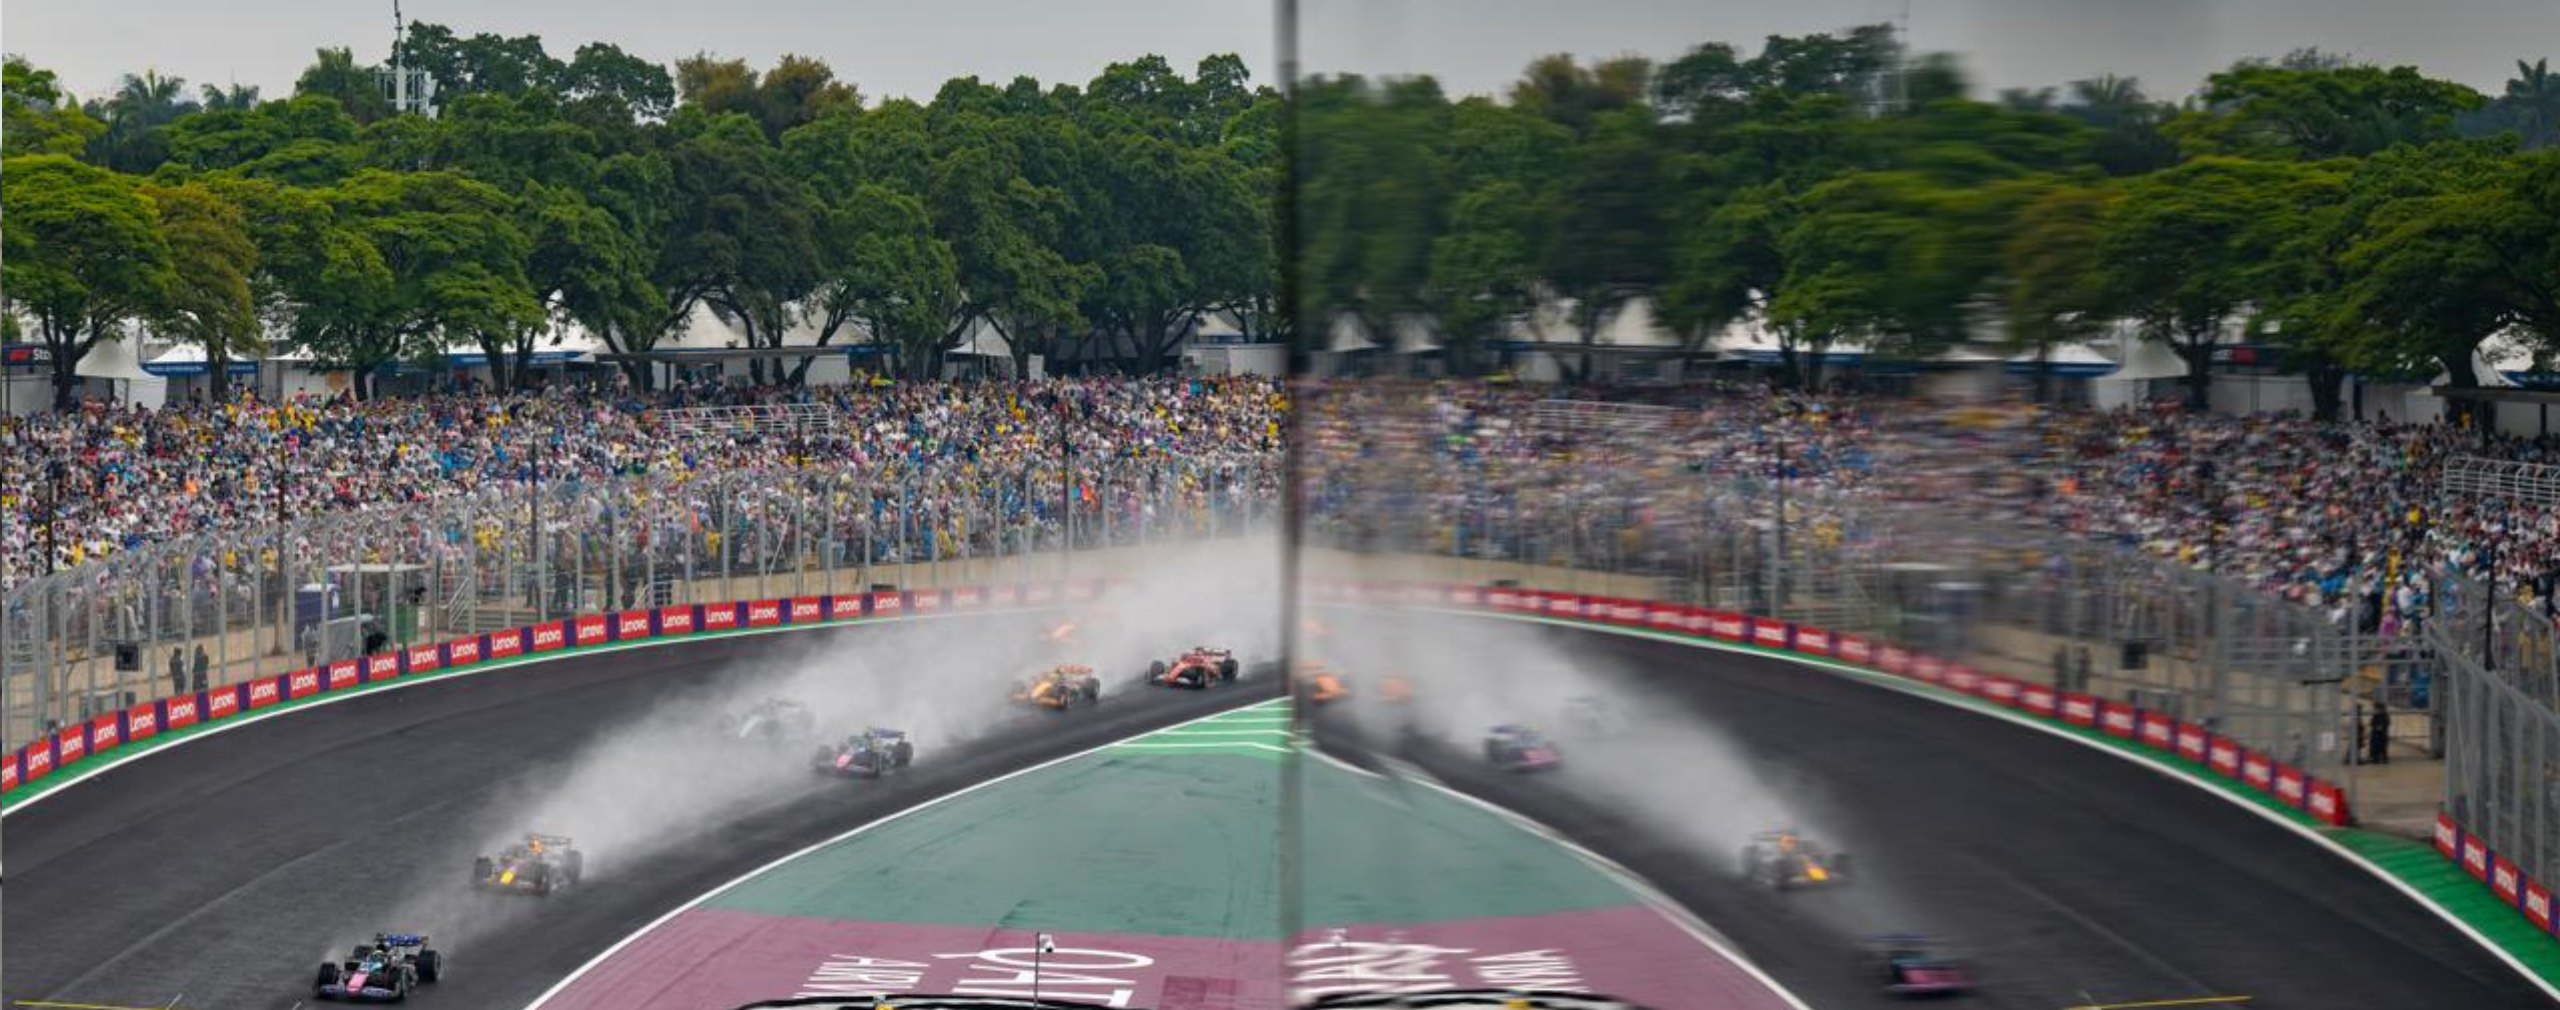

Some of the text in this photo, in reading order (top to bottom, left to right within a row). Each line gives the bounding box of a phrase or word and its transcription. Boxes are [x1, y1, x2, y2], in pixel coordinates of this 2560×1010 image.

[33, 347, 52, 360] Sto
[792, 604, 819, 616] Lenovo
[833, 600, 861, 613] Lenovo
[874, 596, 900, 610] Lenovo
[663, 615, 691, 628] Lenovo
[706, 611, 735, 623] Lenovo
[750, 607, 778, 620] Lenovo
[578, 624, 605, 639] Lenovo
[620, 619, 648, 633] Lenovo
[492, 636, 520, 651] Lenovo
[534, 629, 563, 645] Lenovo
[410, 649, 438, 665] Lenovo
[452, 643, 478, 659] Lenovo
[370, 657, 397, 673] Lenovo
[330, 665, 356, 682] Lenovo
[291, 673, 317, 691] Lenovo
[250, 682, 277, 701] Lenovo
[210, 692, 236, 711] Lenovo
[168, 702, 196, 721] Lenovo
[130, 713, 156, 733] Lenovo
[94, 723, 118, 744] Lenovo
[61, 735, 84, 756] Lenovo
[28, 750, 51, 771] Lenovo
